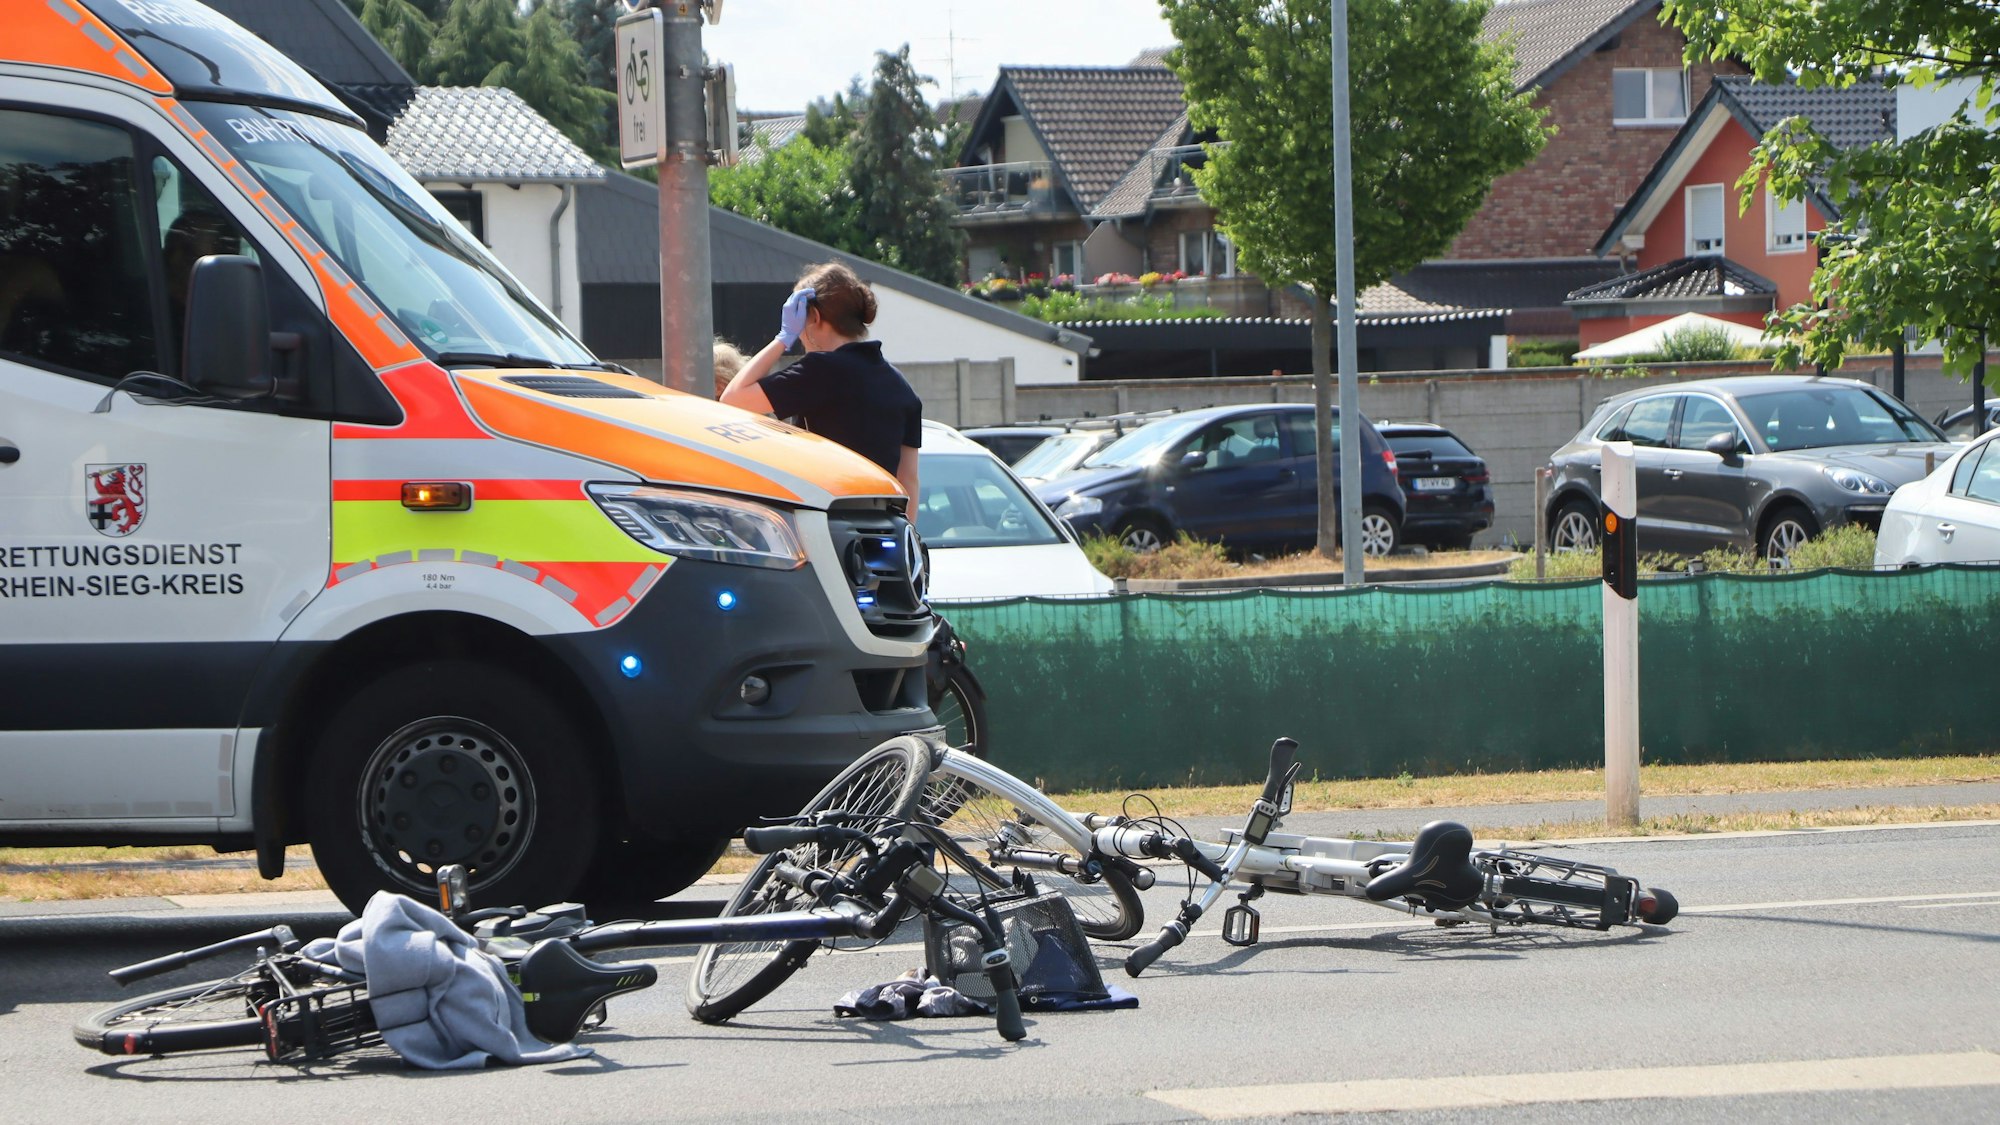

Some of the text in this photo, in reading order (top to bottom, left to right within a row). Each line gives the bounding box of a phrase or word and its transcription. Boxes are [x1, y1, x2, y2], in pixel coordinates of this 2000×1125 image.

[225, 117, 288, 144] BNH
[633, 112, 646, 143] frei
[422, 573, 438, 581] 180
